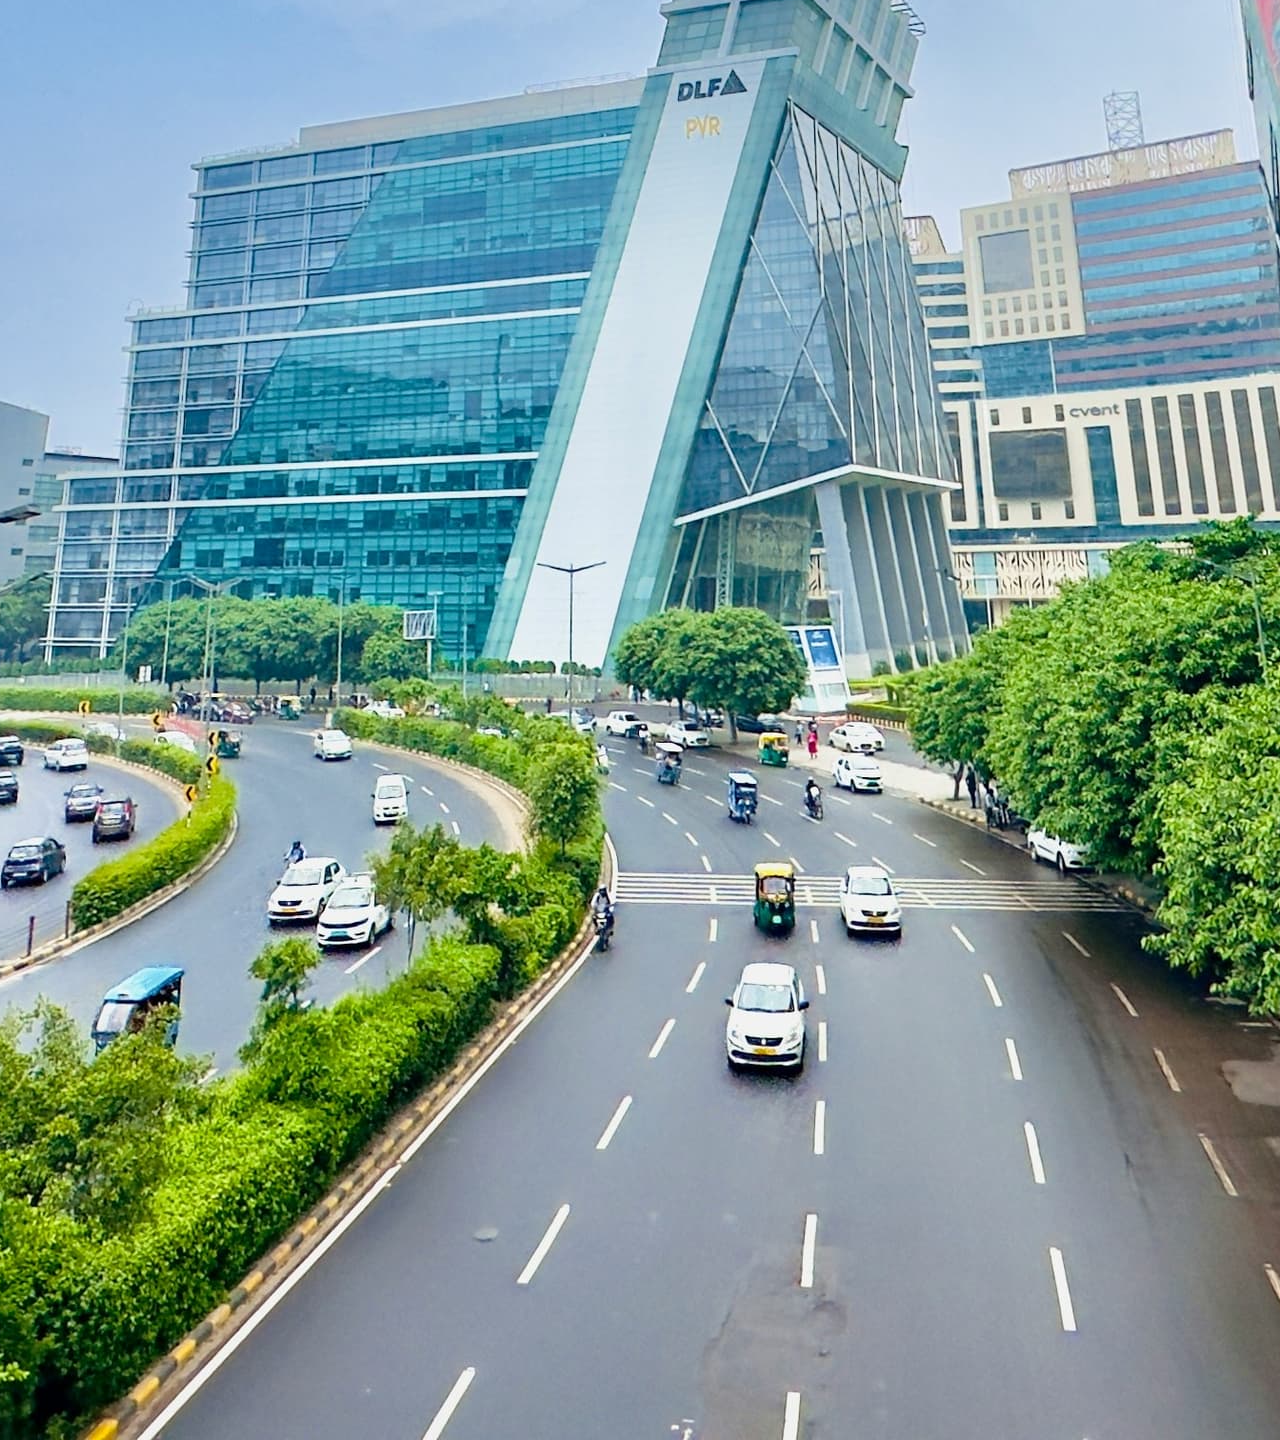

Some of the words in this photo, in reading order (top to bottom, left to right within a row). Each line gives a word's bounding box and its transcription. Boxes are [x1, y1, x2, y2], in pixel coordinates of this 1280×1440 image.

[677, 77, 722, 101] DLF
[686, 113, 720, 139] PVR
[1069, 403, 1120, 418] cvent
